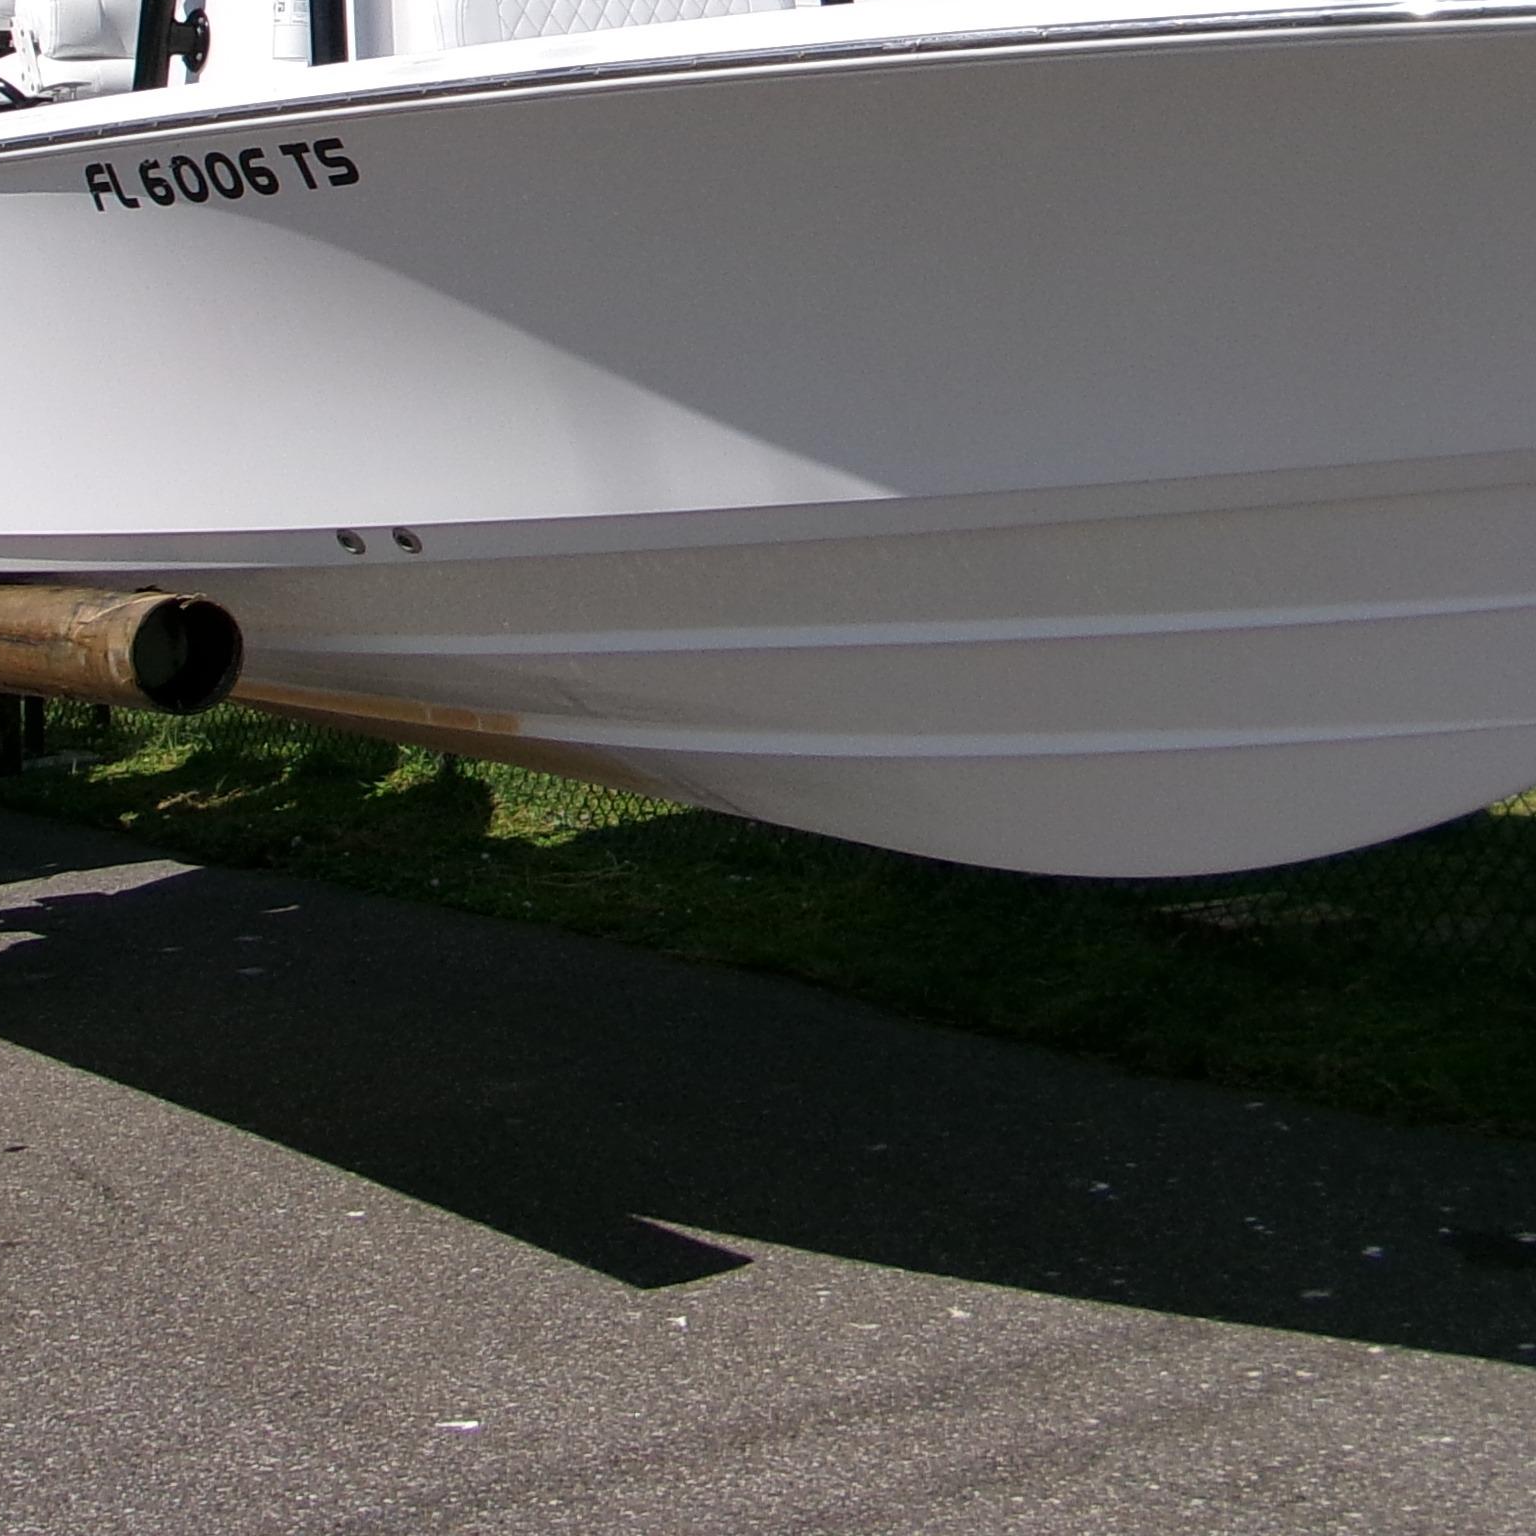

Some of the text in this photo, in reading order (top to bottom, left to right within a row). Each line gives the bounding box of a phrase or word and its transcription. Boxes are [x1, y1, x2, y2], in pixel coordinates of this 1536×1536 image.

[84, 137, 360, 212] FL 6006 TS
